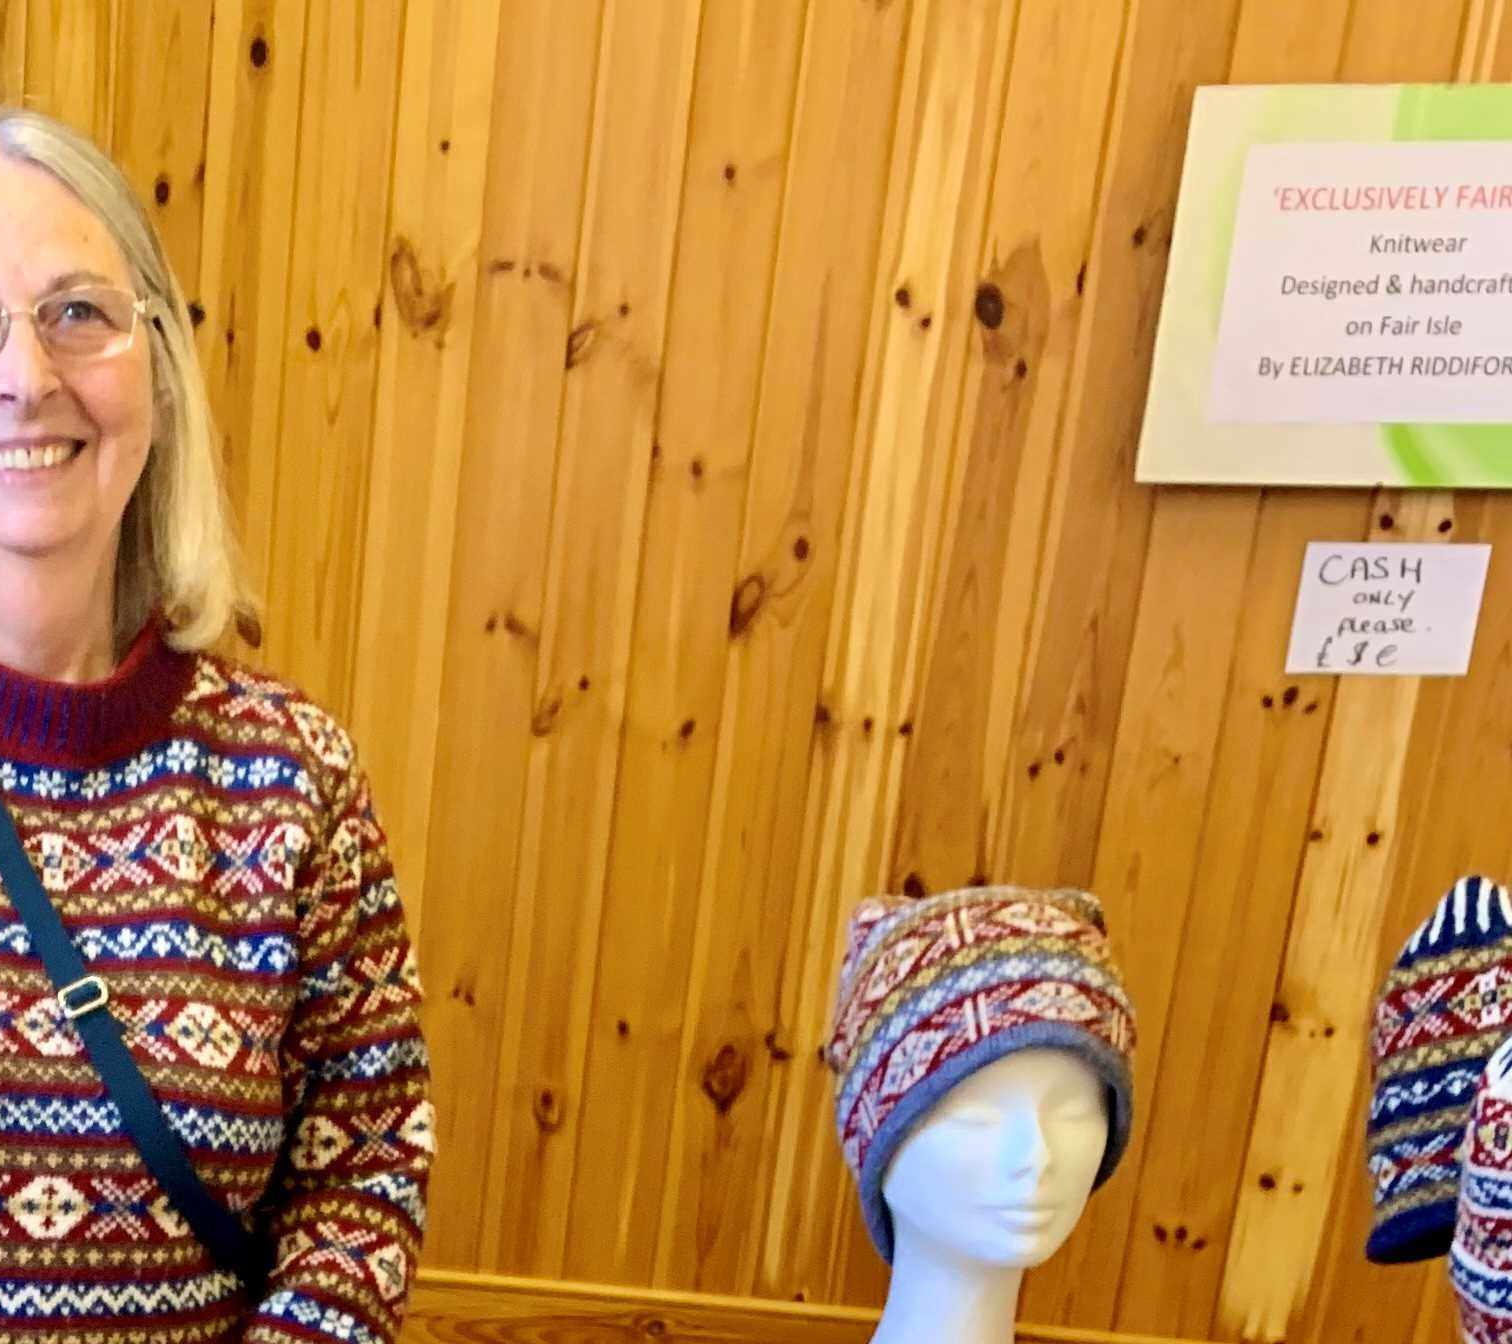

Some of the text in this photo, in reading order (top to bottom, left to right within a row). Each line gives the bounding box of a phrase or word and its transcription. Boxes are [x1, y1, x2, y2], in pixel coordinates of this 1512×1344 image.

[1369, 234, 1468, 254] Knitwear
[1280, 275, 1380, 299] Designed
[1385, 274, 1402, 295] &
[1346, 316, 1463, 336] on Fair Isle
[1258, 357, 1284, 379] By
[1290, 356, 1404, 376] ELIZABETH
[1318, 555, 1422, 585] CASH
[1352, 590, 1415, 612] ONLY
